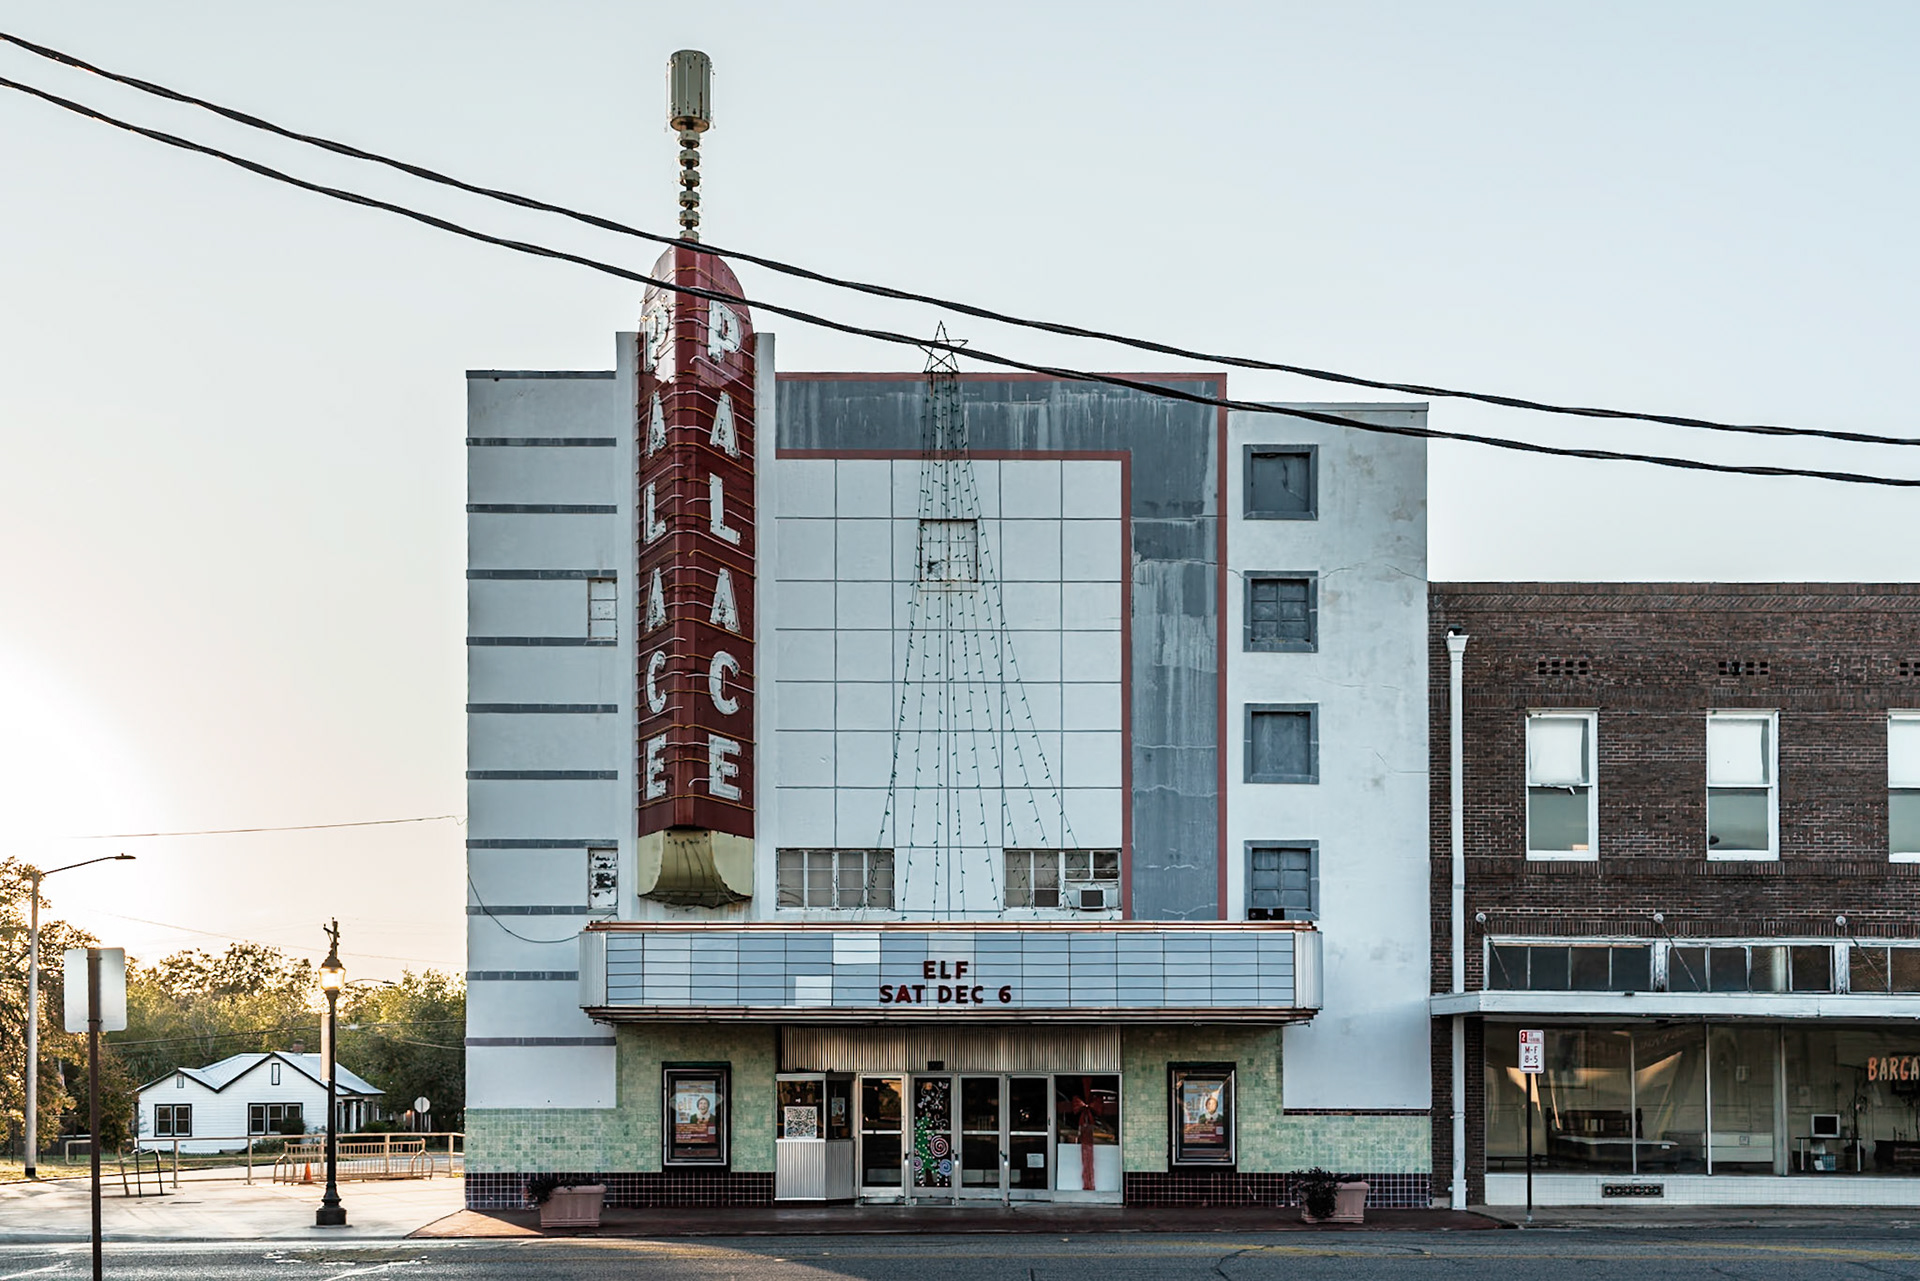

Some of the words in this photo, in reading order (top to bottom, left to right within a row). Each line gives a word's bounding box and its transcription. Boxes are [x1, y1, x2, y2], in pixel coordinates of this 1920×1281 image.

[643, 301, 671, 801] PALACE
[708, 299, 742, 801] PALACE
[923, 960, 968, 980] ELF
[879, 985, 925, 1003] SAT
[938, 985, 983, 1003] DEC
[998, 985, 1011, 1003] 6
[1521, 1032, 1527, 1042] 2
[1868, 1056, 1920, 1081] BARGA
